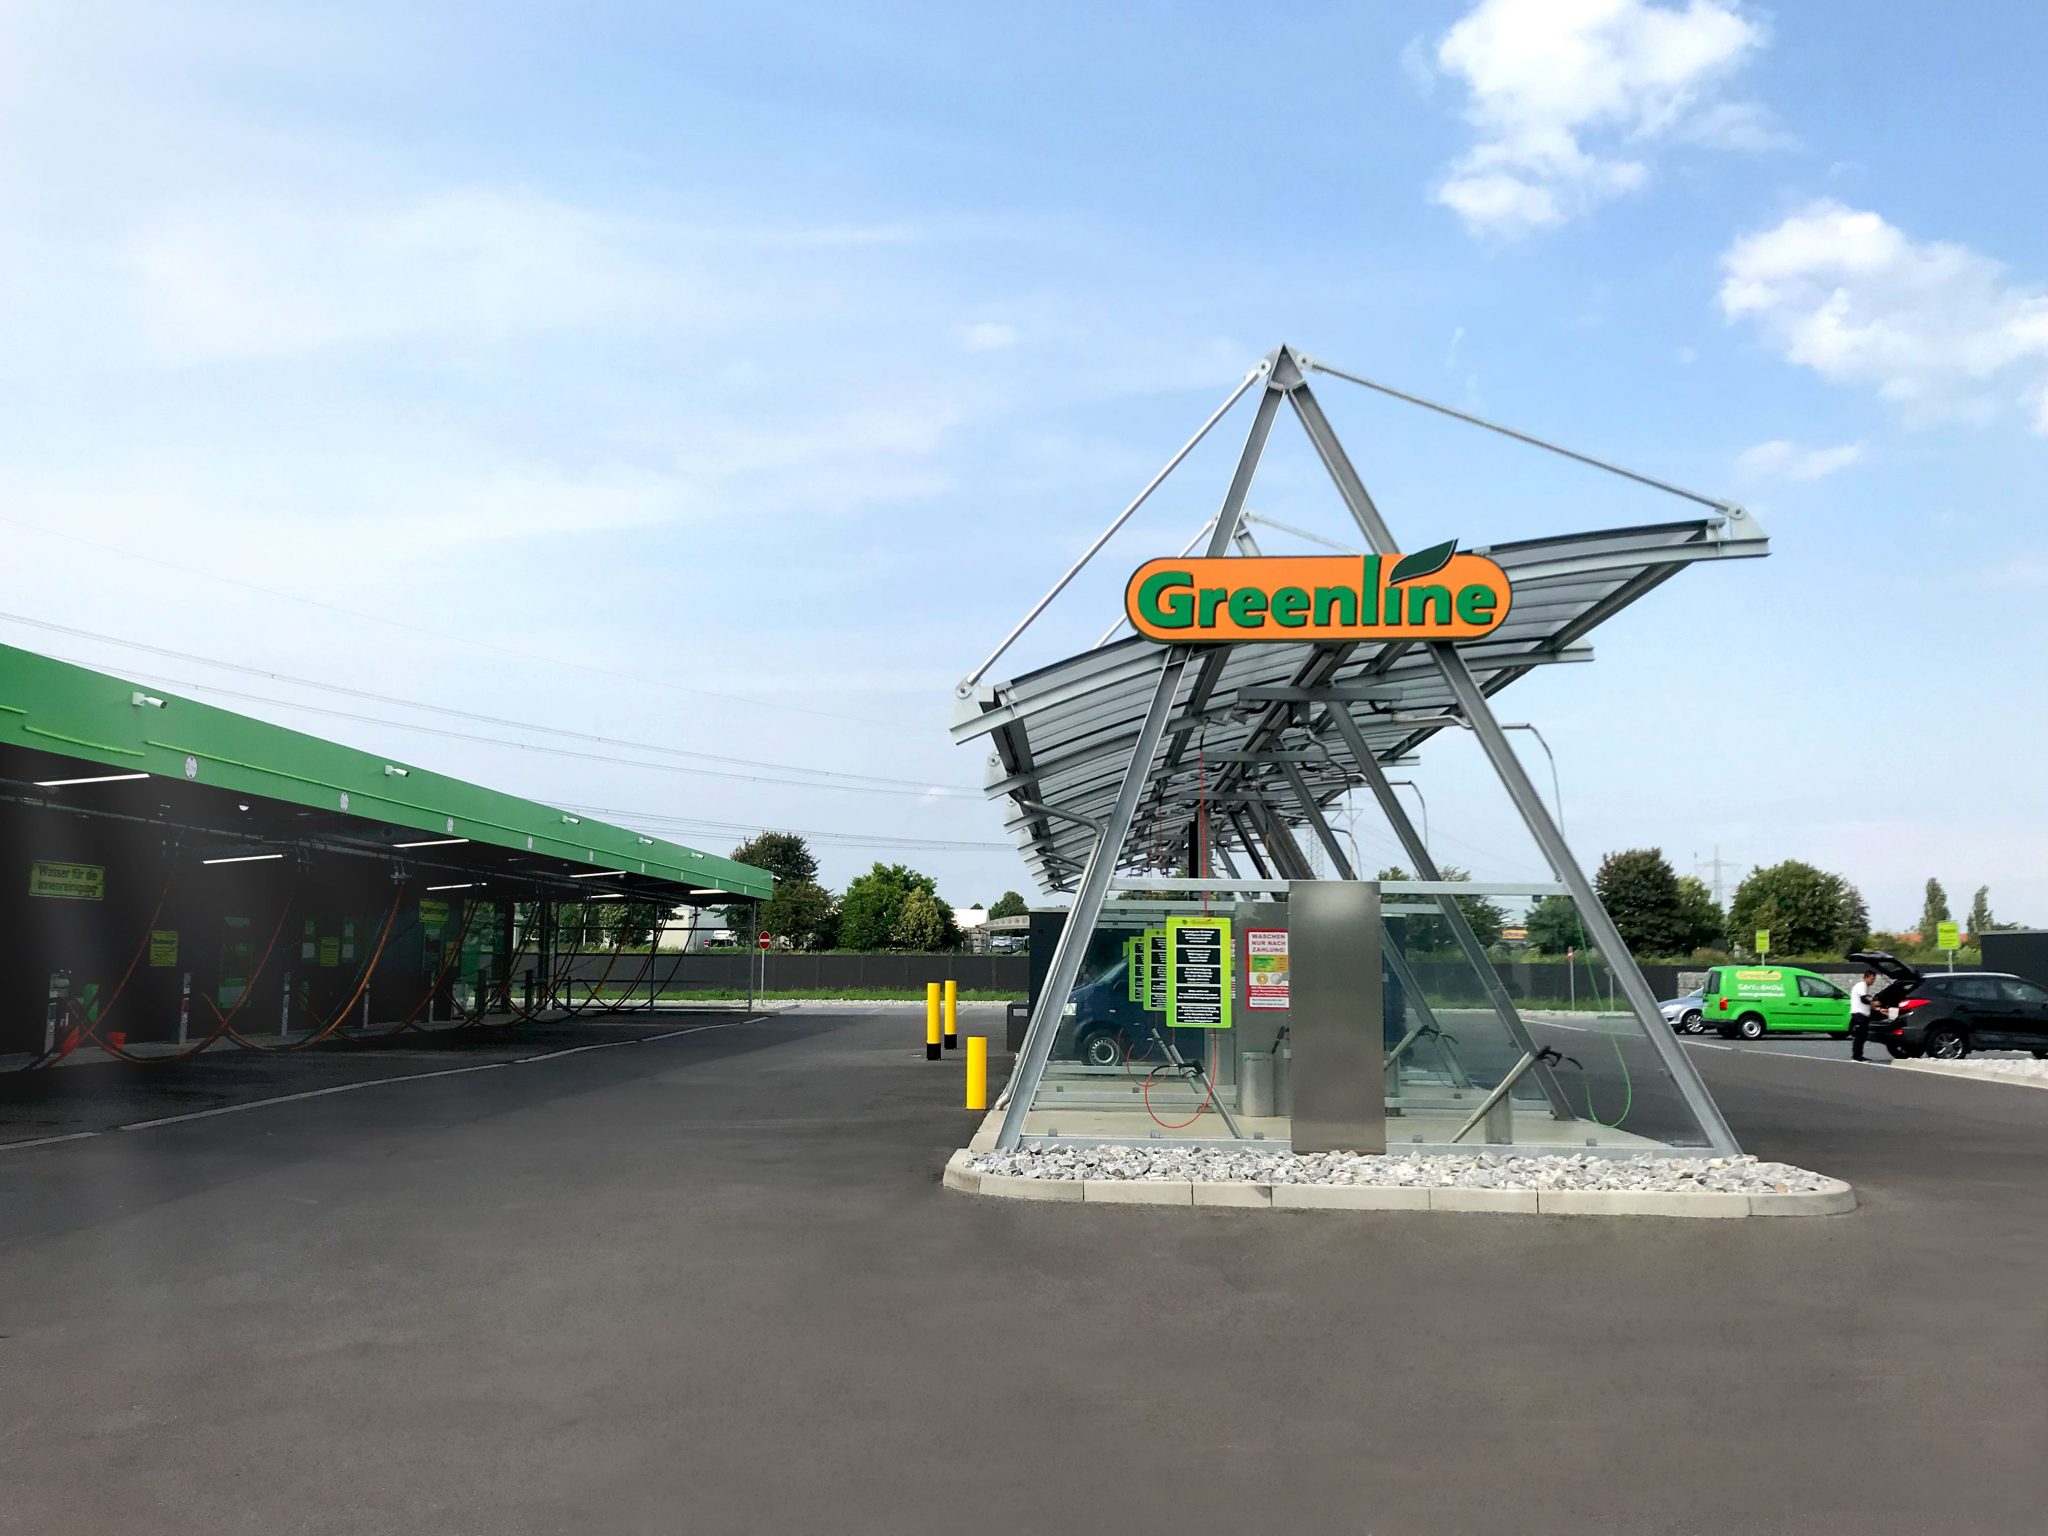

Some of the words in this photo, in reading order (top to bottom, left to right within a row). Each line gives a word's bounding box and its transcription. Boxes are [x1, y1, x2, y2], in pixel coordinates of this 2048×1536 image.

[1136, 555, 1499, 629] Greenline
[39, 865, 70, 878] Wasser
[72, 867, 85, 880] für
